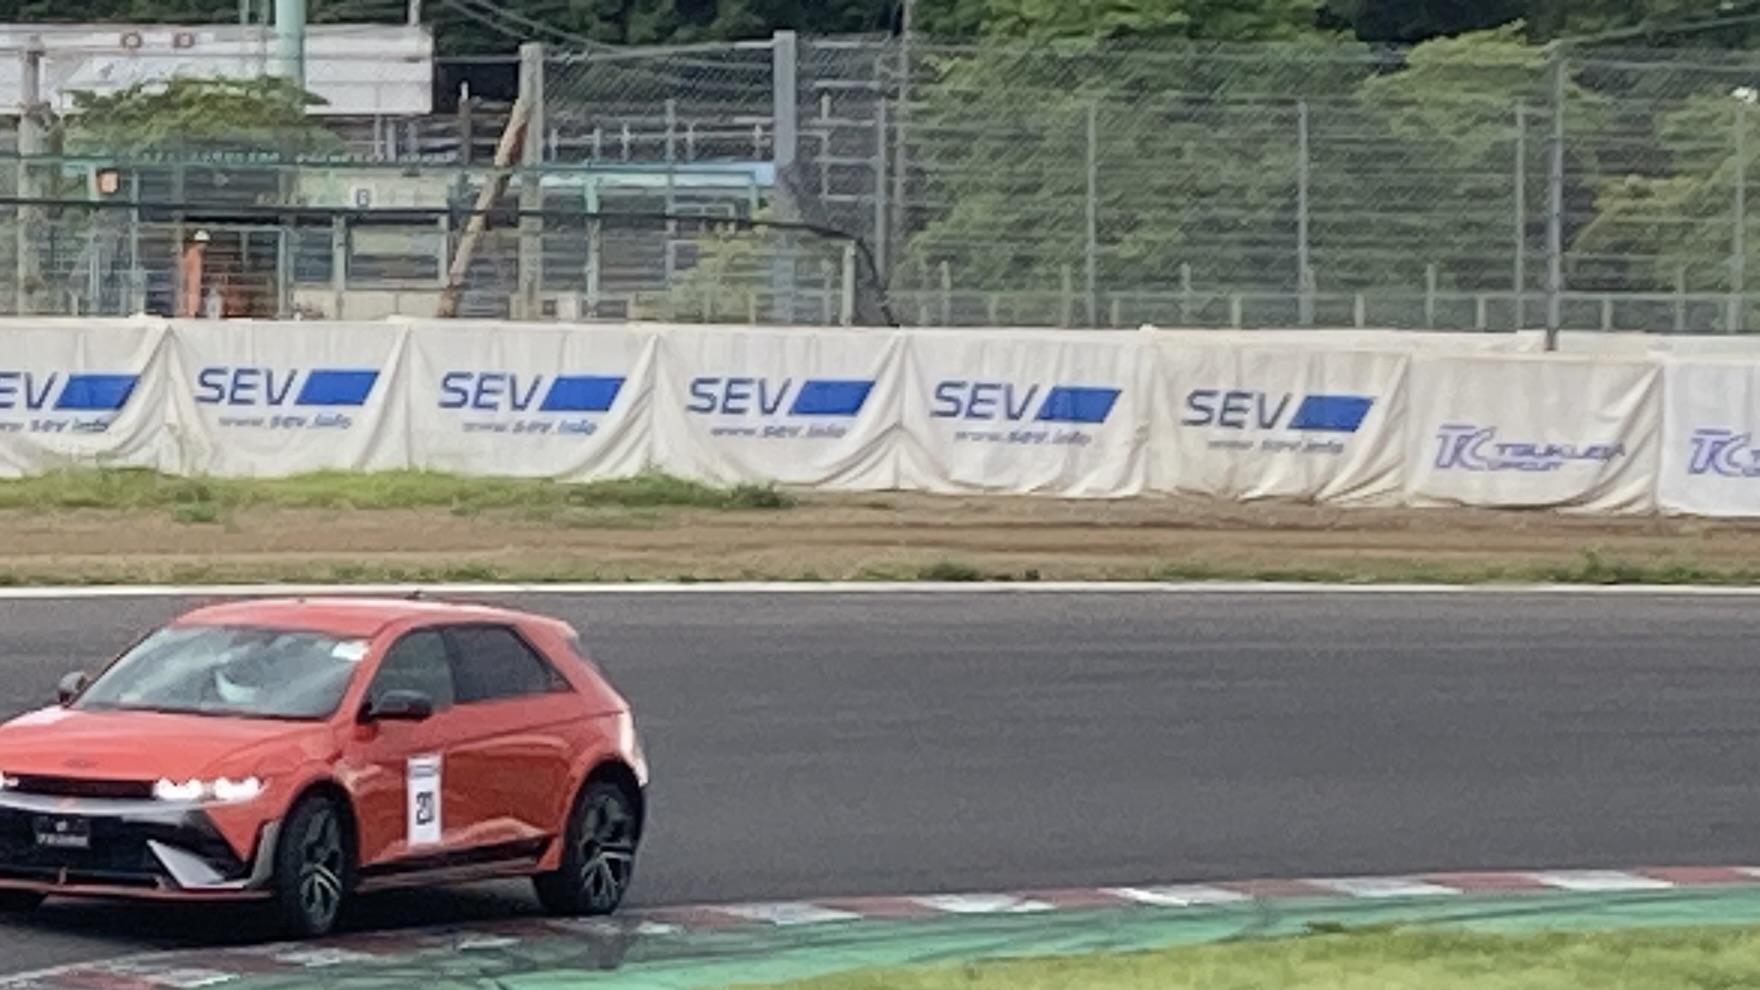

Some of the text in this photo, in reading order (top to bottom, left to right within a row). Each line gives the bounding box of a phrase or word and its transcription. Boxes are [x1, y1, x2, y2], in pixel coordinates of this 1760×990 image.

[194, 368, 297, 405] SEV
[438, 371, 542, 411] SEV
[686, 377, 792, 414] SEV
[930, 381, 1039, 420] SEV
[1181, 389, 1292, 429] SEV
